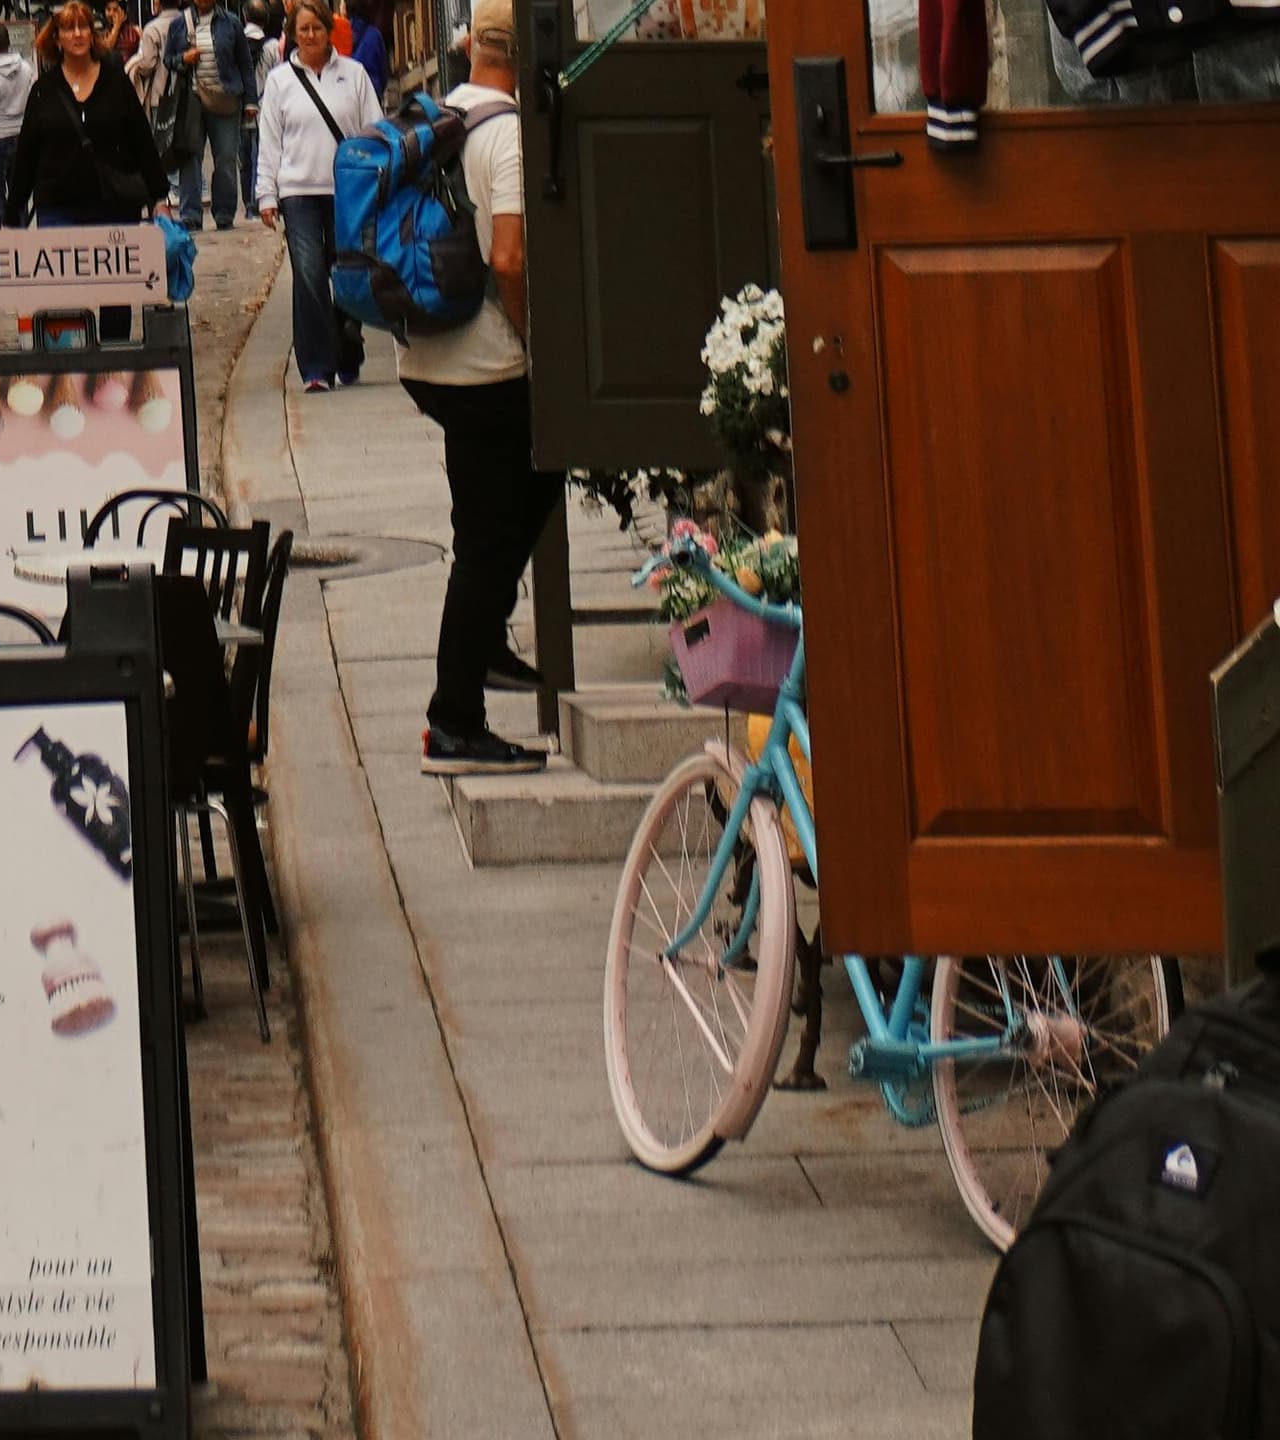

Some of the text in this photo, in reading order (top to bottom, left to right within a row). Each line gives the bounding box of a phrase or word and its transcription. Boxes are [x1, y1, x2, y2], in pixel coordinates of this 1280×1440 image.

[28, 1255, 112, 1282] pour un
[52, 1288, 77, 1313] de
[85, 1288, 115, 1313] vie
